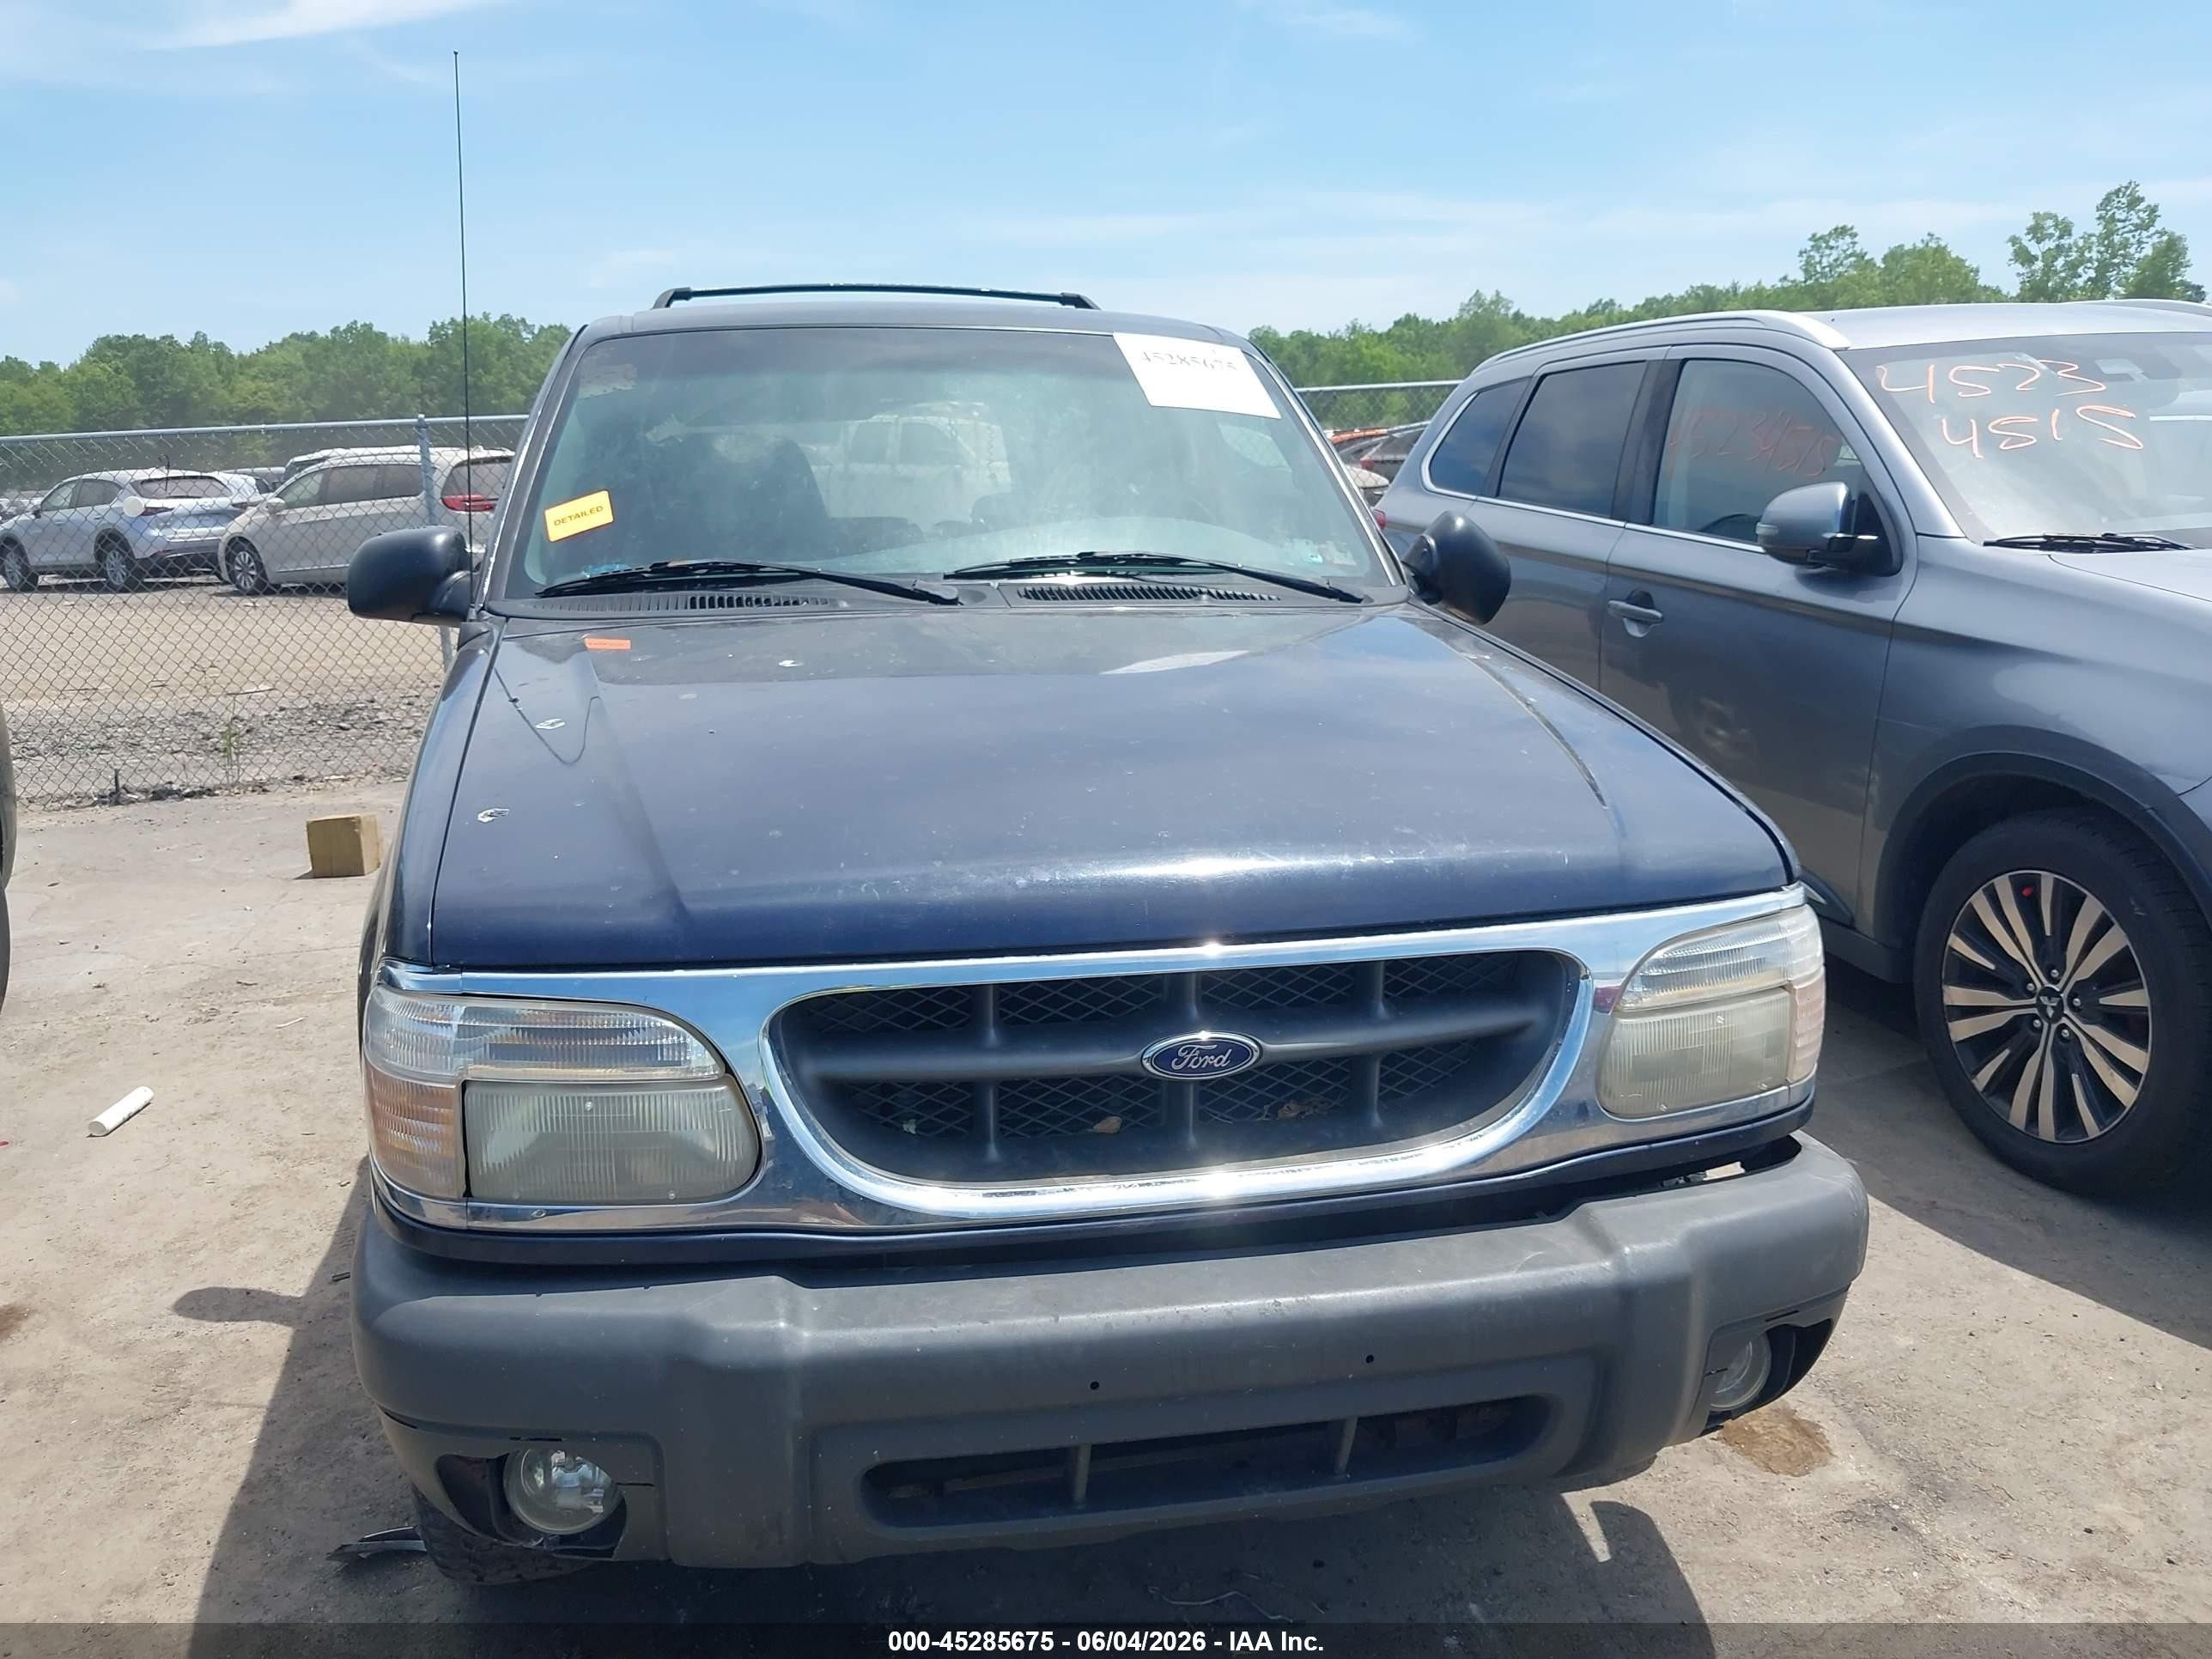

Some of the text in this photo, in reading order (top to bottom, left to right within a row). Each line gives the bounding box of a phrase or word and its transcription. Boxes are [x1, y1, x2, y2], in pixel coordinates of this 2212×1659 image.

[1875, 359, 2107, 405] 4523
[1941, 404, 2145, 459] 4515
[553, 505, 604, 526] DETAILED
[1170, 1044, 1232, 1071] Ford
